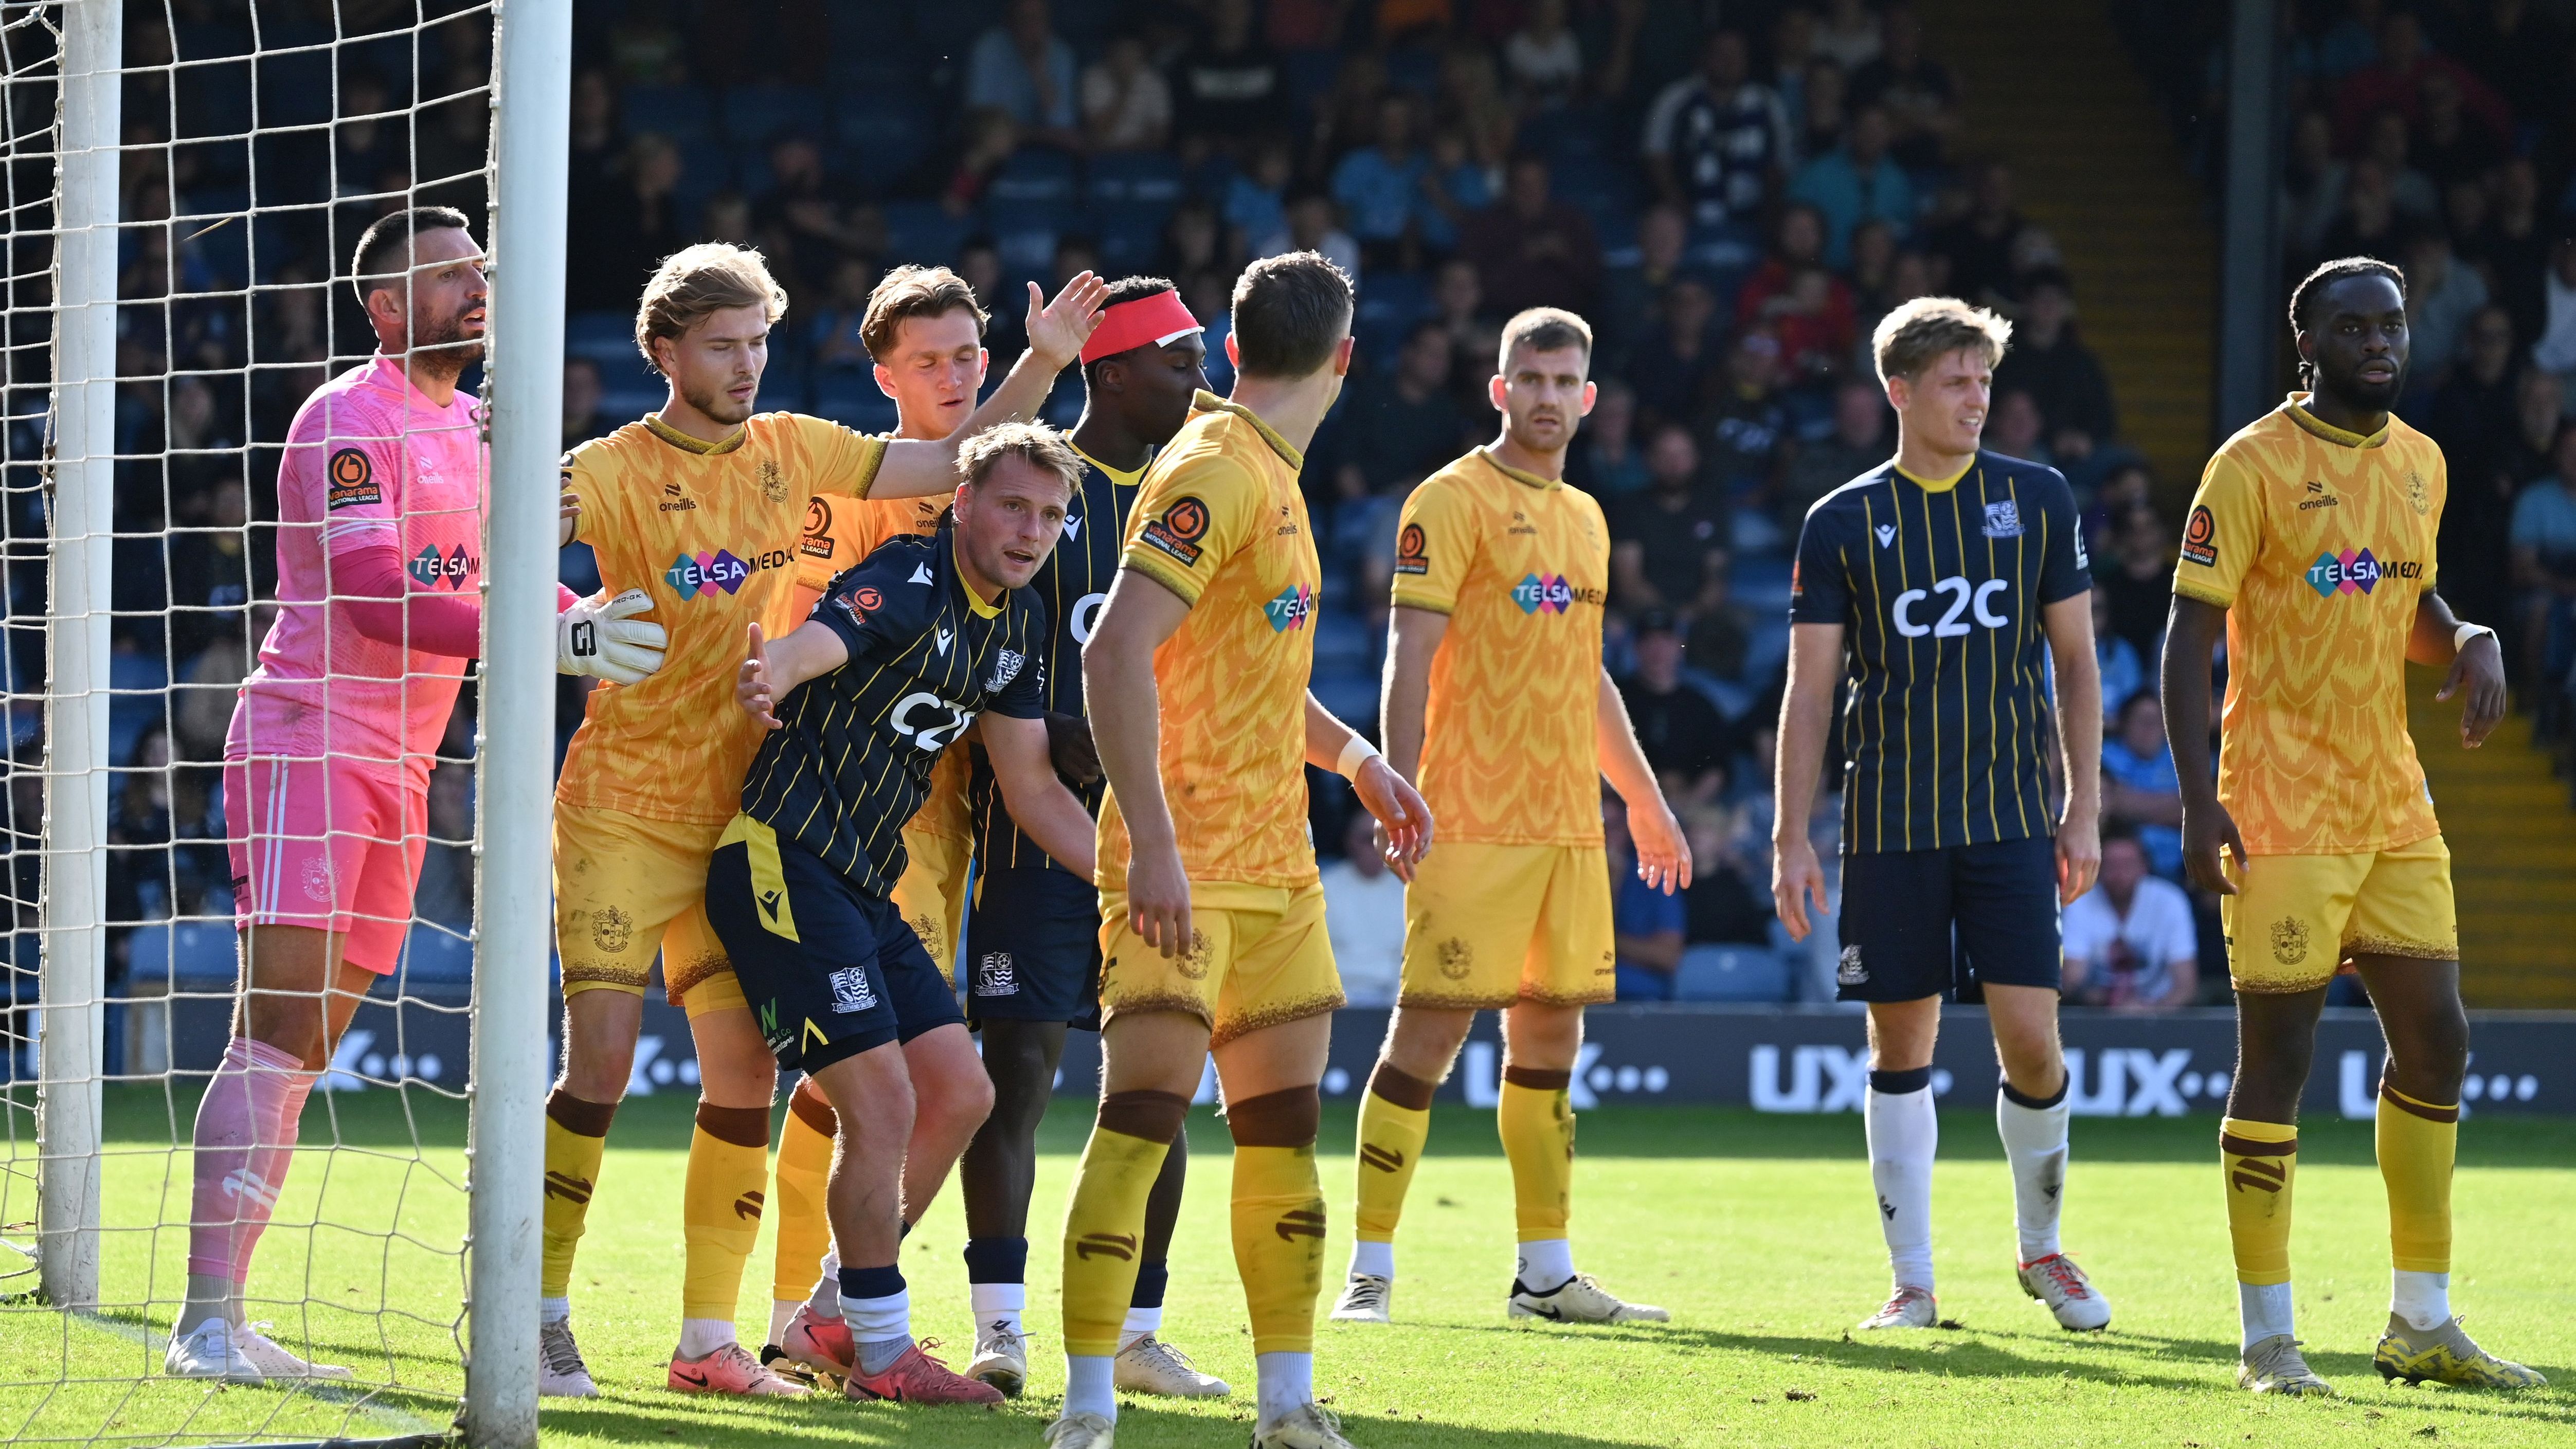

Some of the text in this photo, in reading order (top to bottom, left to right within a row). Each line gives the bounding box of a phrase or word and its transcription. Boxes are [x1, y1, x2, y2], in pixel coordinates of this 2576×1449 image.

[330, 486, 377, 500] vanarama
[330, 497, 358, 506] NATIONAL
[806, 545, 829, 555] LEAGUE
[1144, 532, 1193, 563] NATIONAL LEAGUE
[1149, 525, 1198, 557] vanarama
[414, 557, 469, 575] TELSA
[2192, 553, 2212, 564] LEAGUE
[669, 561, 746, 586] TELSA
[2310, 562, 2379, 583] TELSA
[612, 593, 642, 606] PRO-GK
[1516, 584, 1572, 603] TELSA
